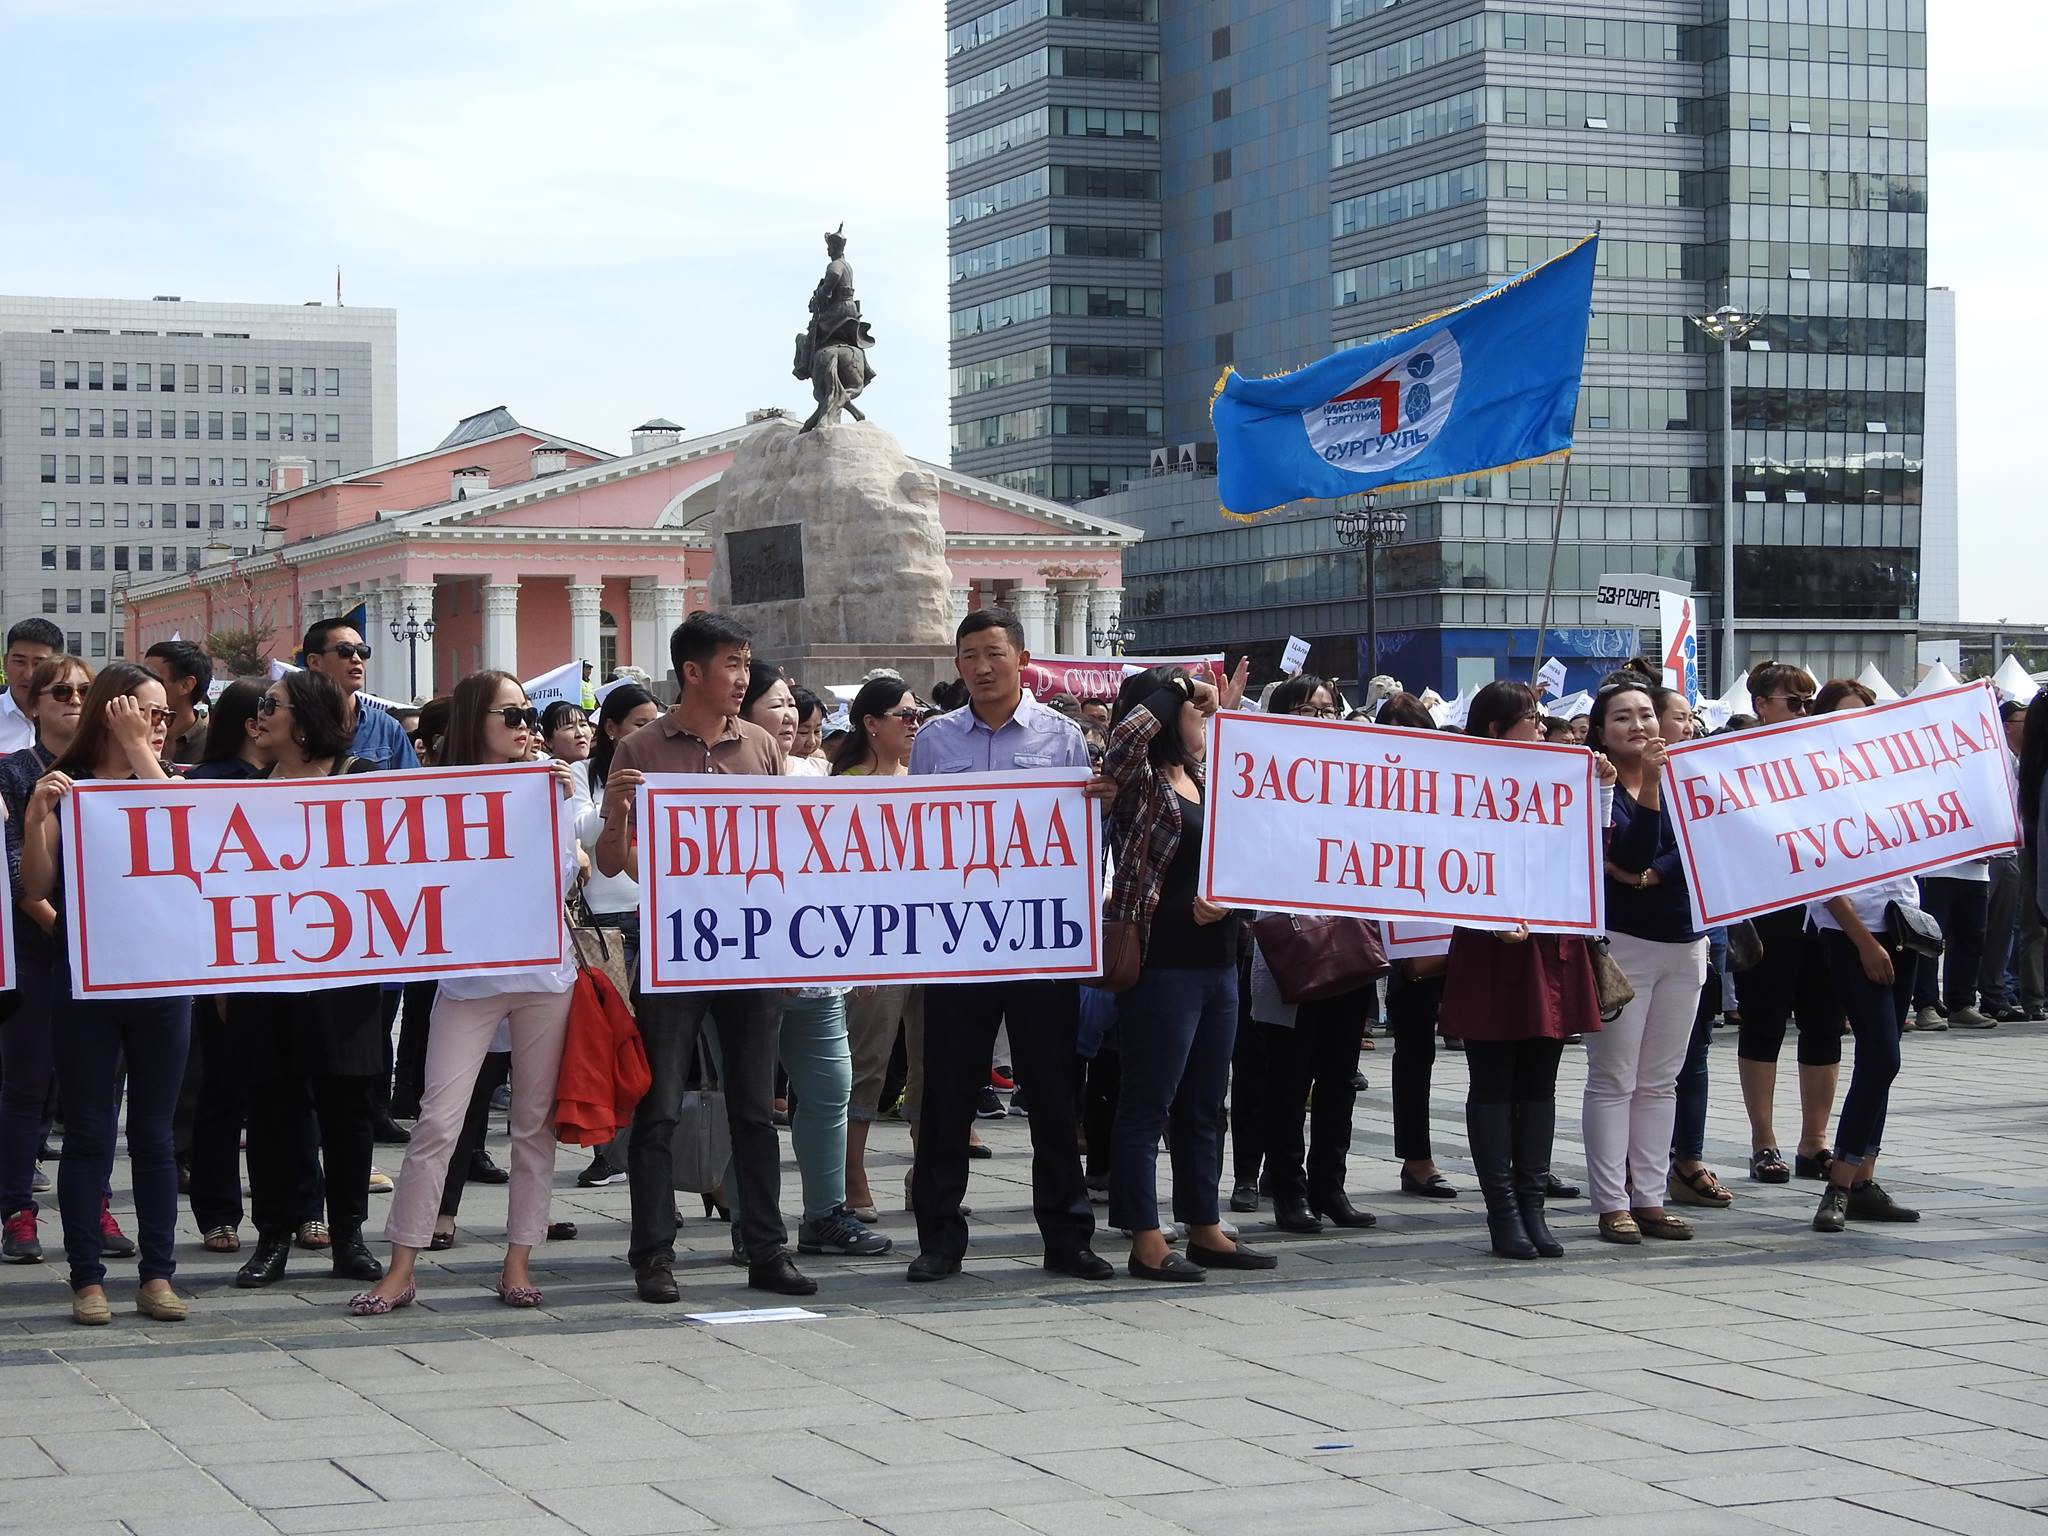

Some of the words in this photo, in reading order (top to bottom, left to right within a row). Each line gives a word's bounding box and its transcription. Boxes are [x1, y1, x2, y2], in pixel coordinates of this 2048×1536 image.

[1324, 429, 1429, 461] СУРГУУЛЬ
[1232, 751, 1439, 815] ЗАСГИЙН
[1451, 773, 1574, 827] ГАЗАР
[1681, 757, 1808, 822] БАГШ
[1804, 712, 2000, 792] БАГШДАА
[118, 790, 516, 894] ЦАЛИН
[666, 804, 785, 893] БИД
[797, 799, 1078, 888] ХАМТДАА
[1314, 837, 1427, 903] ГАРЦ
[1437, 848, 1498, 897] ОЛ
[1776, 790, 1974, 875] ТУСАЛЪЯ
[207, 885, 454, 968] НЭМ
[667, 906, 773, 963] 18-Р
[788, 896, 1084, 960] СУРГУУЛЬ
